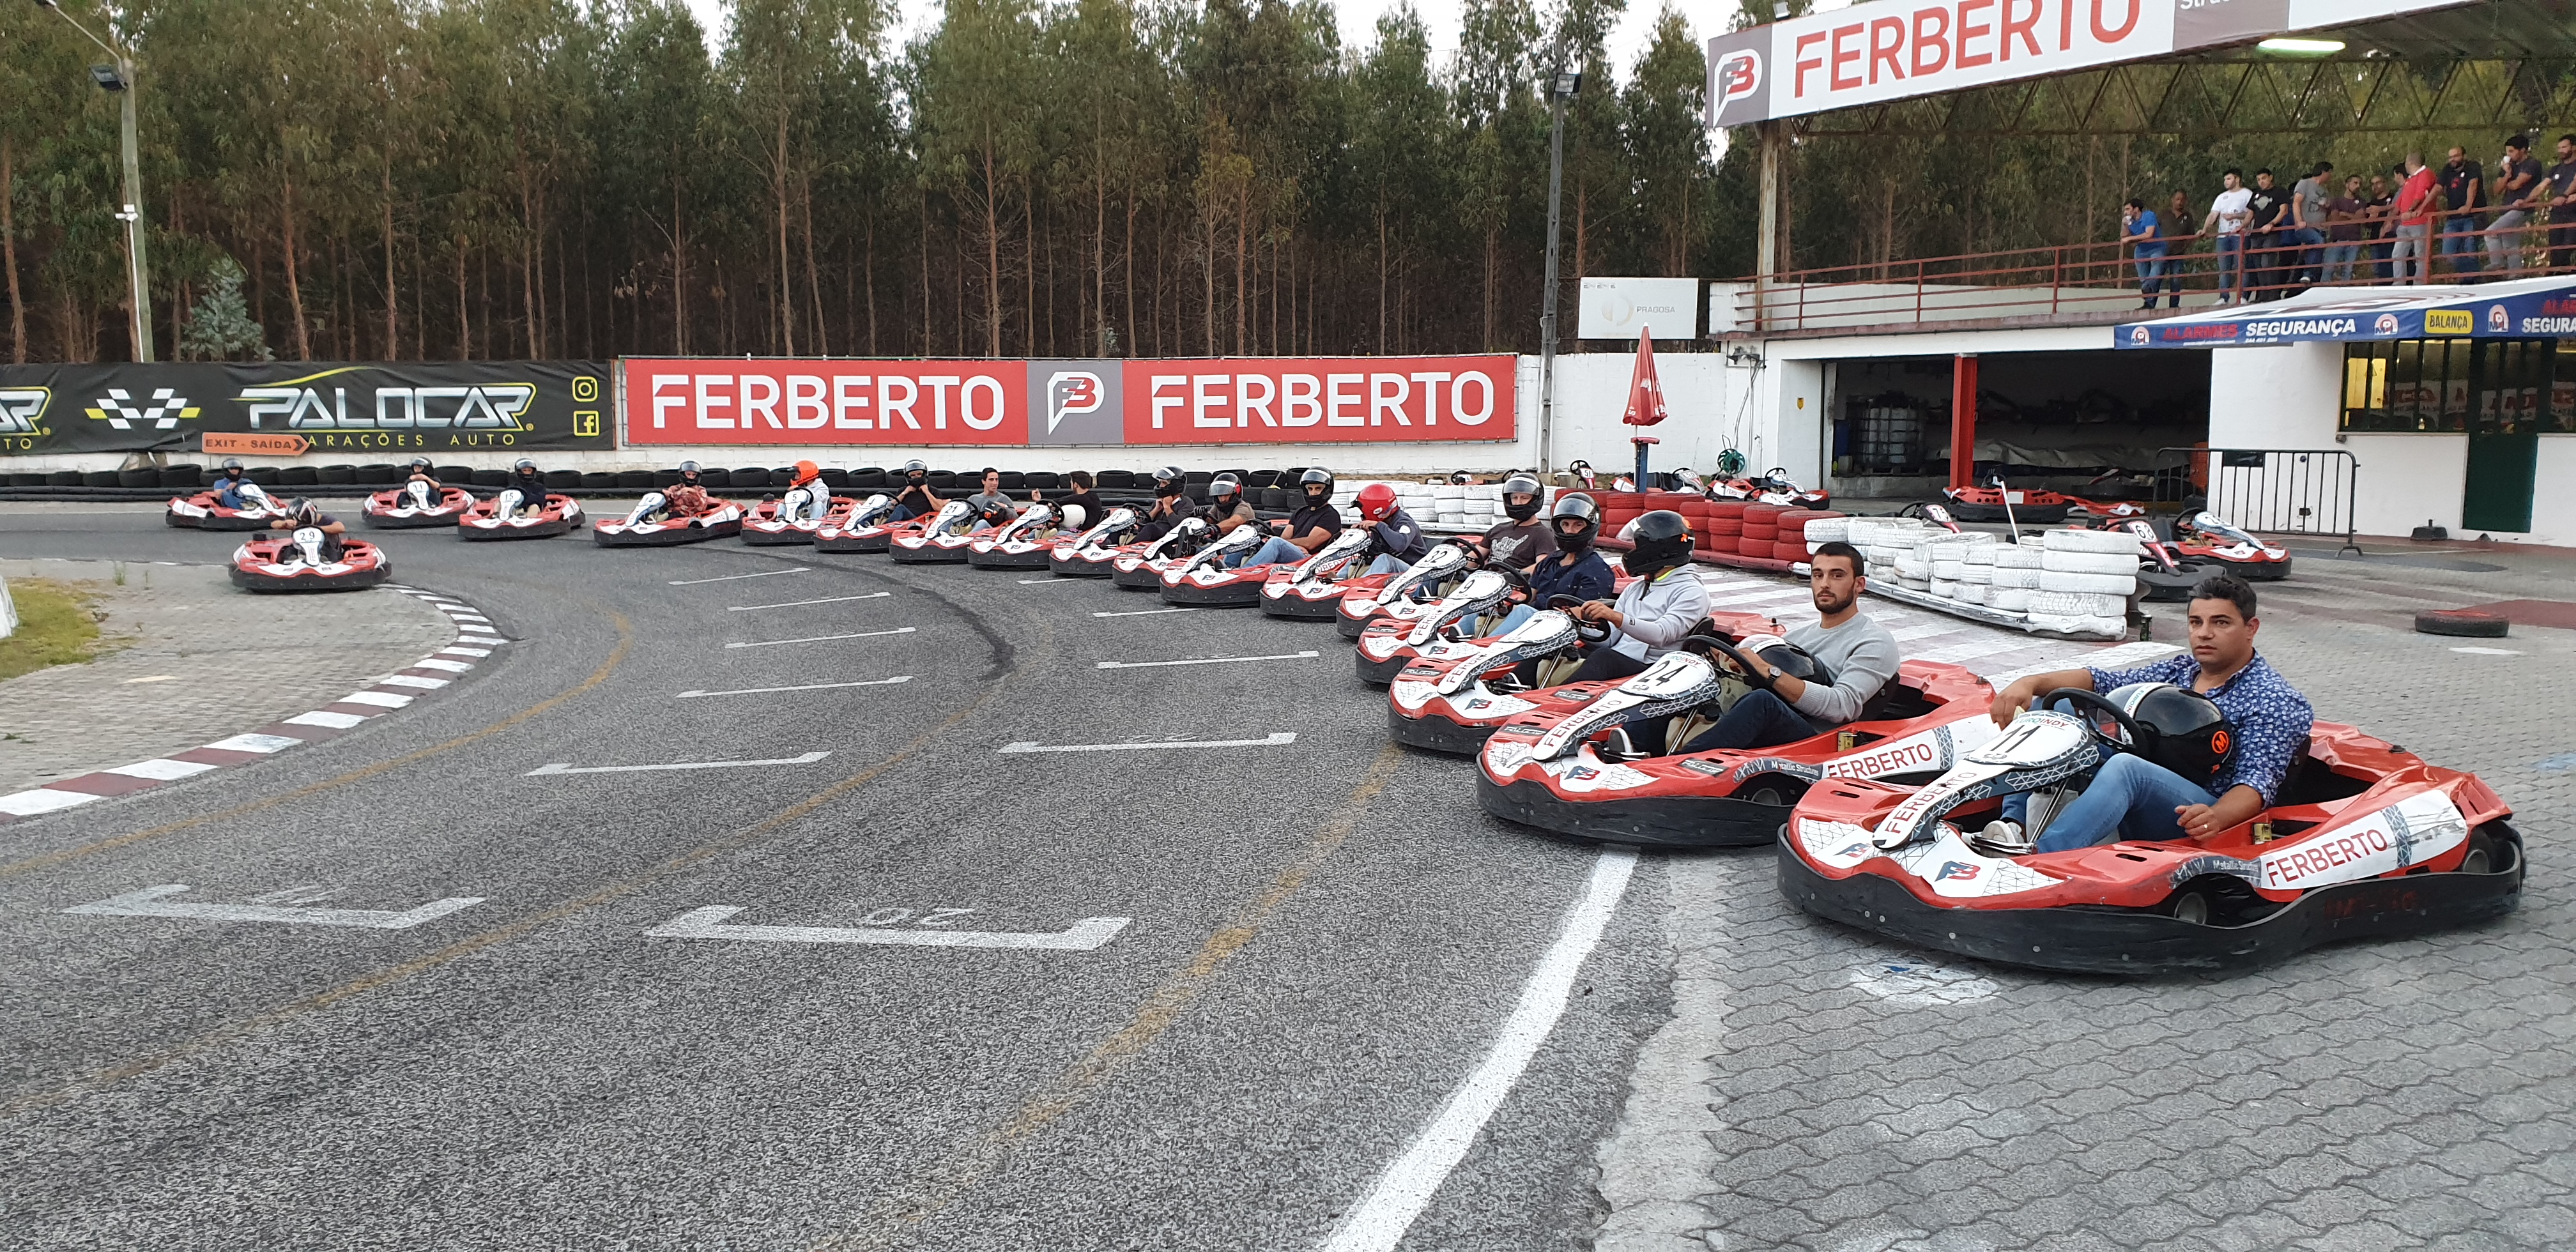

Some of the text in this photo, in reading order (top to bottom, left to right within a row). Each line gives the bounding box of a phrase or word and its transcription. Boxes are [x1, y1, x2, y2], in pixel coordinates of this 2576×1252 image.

[2162, 323, 2239, 341] ALARMES
[2245, 318, 2357, 337] SEGURANÇA
[2429, 315, 2468, 331] BALANÇA
[239, 386, 534, 429] PALOCAR
[652, 374, 1005, 430] FERBERTO
[1151, 370, 1494, 429] FERBERTO
[206, 439, 236, 448] EXIT
[250, 438, 292, 449] SAÍDA
[308, 432, 515, 449] ARAÇÕES AUTO
[792, 493, 797, 501] 5
[299, 531, 316, 541] 29
[1424, 550, 1448, 563] 32
[1459, 579, 1475, 594] 9
[1636, 660, 1689, 687] 24
[1544, 699, 1623, 747] FERBERTO
[1989, 724, 2042, 754] 11
[1884, 772, 1977, 834] FERBERTO
[2266, 828, 2389, 887] FERBERTO
